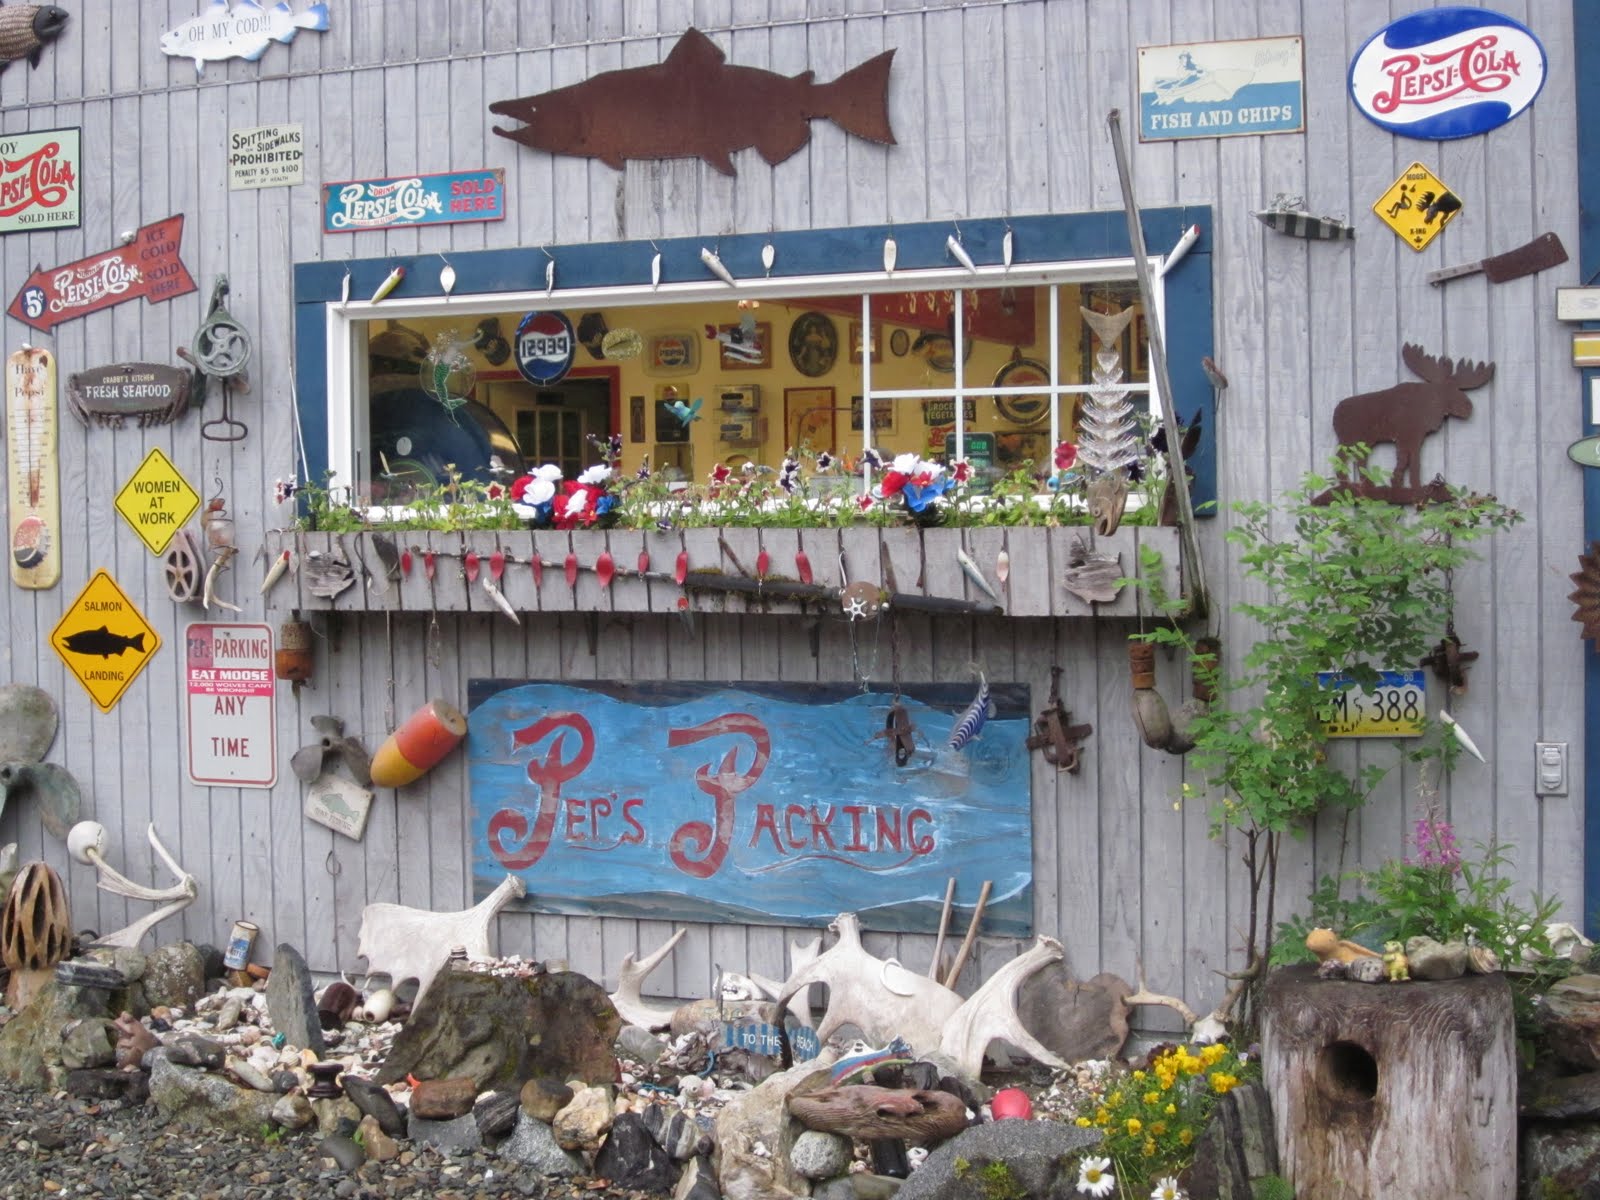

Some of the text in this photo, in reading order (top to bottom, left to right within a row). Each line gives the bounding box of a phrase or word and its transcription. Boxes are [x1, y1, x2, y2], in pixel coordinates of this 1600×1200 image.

[188, 15, 271, 42] OH MY COD!!!
[1151, 105, 1293, 130] FISH AND CHIPS
[232, 128, 279, 150] SPITTING
[256, 132, 301, 152] SIDEWALKS
[232, 150, 300, 166] PROHIBITED
[234, 168, 257, 178] PENALTY
[260, 166, 270, 176] $5
[281, 164, 299, 173] $100
[1406, 172, 1428, 181] MOOSE
[451, 178, 495, 196] SOLD
[451, 196, 497, 213] HERE
[18, 210, 75, 225] SOLD HERE
[146, 228, 166, 244] ICE
[141, 241, 177, 260] COLD
[147, 262, 180, 281] SOLD
[151, 277, 182, 295] HERE
[15, 364, 42, 375] Have
[131, 373, 155, 383] KITCHEN
[15, 386, 44, 400] Pepsi
[85, 384, 171, 399] FRESH SEAFOOD
[133, 480, 181, 494] WOMEN
[149, 496, 164, 509] AT
[139, 512, 176, 525] WORK
[84, 601, 122, 612] SALMON
[214, 638, 268, 659] PARKING
[84, 669, 124, 681] LANDING
[191, 669, 269, 681] EAT MOOSE
[214, 695, 247, 716] ANY
[1371, 689, 1419, 723] 388
[211, 737, 250, 758] TIME
[488, 711, 936, 879] PEP'S PACKING
[742, 1032, 781, 1047] TO THE
[796, 1035, 815, 1052] BEACH
